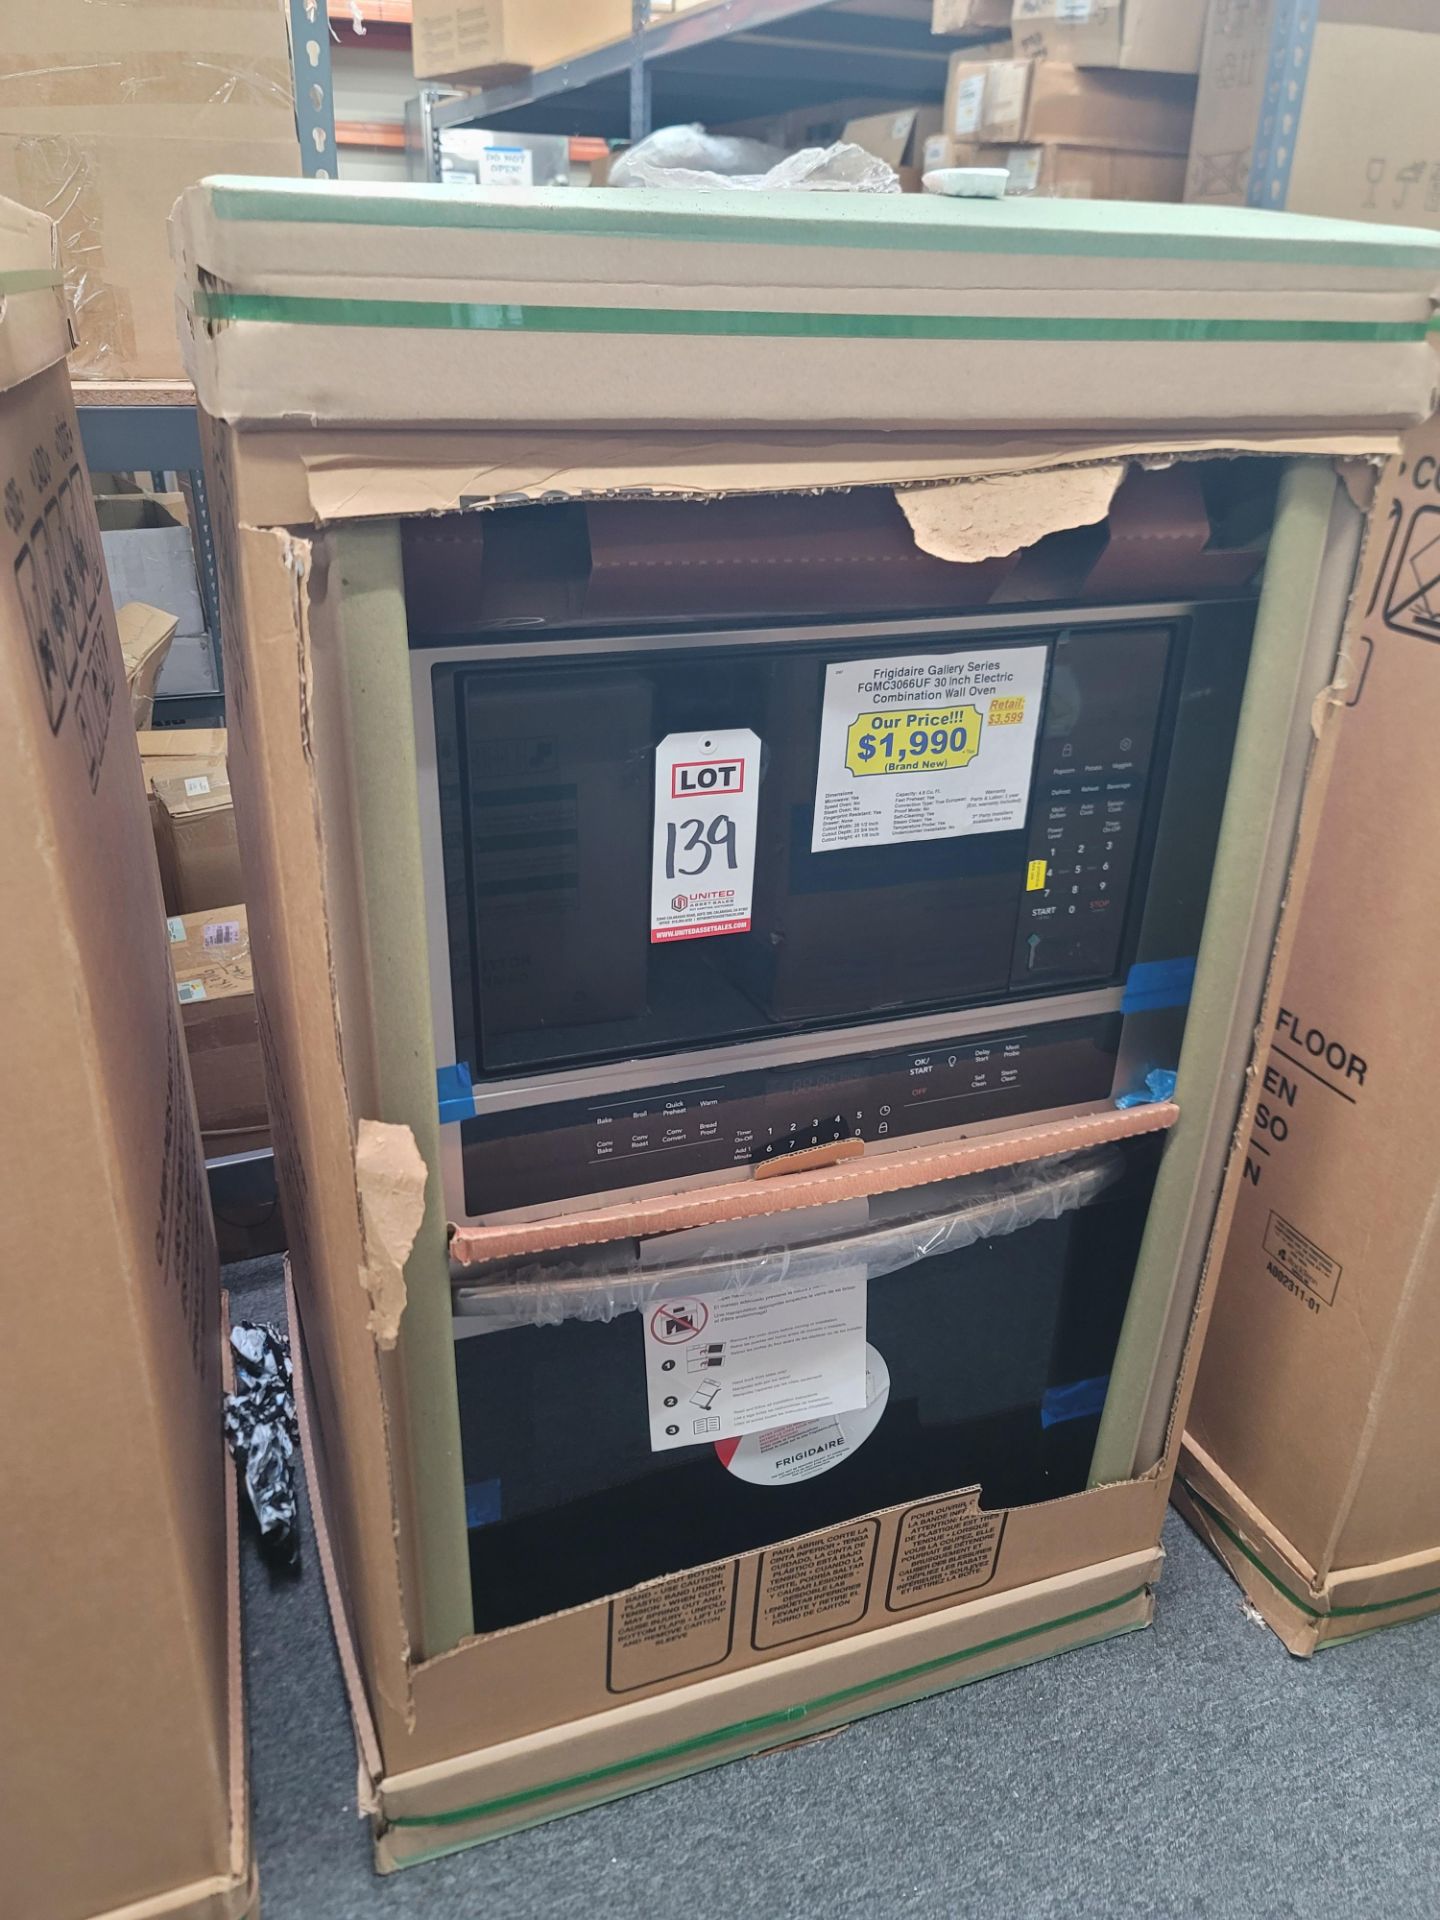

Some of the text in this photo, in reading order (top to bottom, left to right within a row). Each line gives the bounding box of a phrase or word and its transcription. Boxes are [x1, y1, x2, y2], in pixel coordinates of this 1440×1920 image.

[874, 661, 1000, 680] Frigidaire Gallery Series
[858, 678, 931, 692] FGMC3066UF
[935, 678, 946, 687] 30
[974, 672, 1014, 684] Electric
[873, 686, 996, 703] Combination Wall Oven
[989, 697, 1024, 710] Retail:
[871, 711, 963, 729] Our Price!!!
[858, 727, 967, 762] $1,990
[885, 759, 947, 773] (Brand New)
[681, 767, 736, 791] LOT
[666, 815, 738, 879] 139
[1051, 841, 1113, 856] 1 2 3
[1047, 862, 1109, 876] 4 5 6
[690, 889, 735, 900] UNITED
[1044, 882, 1106, 897] 7 8 9
[1032, 907, 1056, 916] START
[1068, 905, 1075, 914] 0
[656, 922, 747, 938] WWW.UNITEDASSETSALES.COM
[1275, 1007, 1368, 1086] FLOOR
[915, 1057, 930, 1066] OK/
[910, 1066, 933, 1076] START
[912, 1088, 928, 1097] OFF
[1262, 1065, 1298, 1107] EN
[666, 1101, 684, 1109] Quick
[633, 1110, 648, 1118] Broil
[663, 1108, 686, 1116] Preheat
[768, 1127, 772, 1135] 1
[857, 1111, 862, 1119] 5
[766, 1145, 773, 1153] 6
[812, 1136, 817, 1144] 8
[855, 1128, 860, 1136] 0
[1267, 1262, 1320, 1314] A002311-01
[776, 1437, 845, 1469] FRIGIDAIRE
[911, 1510, 934, 1521] POUR
[921, 1514, 946, 1525] BANDE
[911, 1517, 958, 1534] ATTENTION:
[918, 1524, 961, 1539] PLASTIQUE
[913, 1522, 989, 1547] TENDUE LORSQUE
[773, 1546, 795, 1557] PARA
[827, 1530, 855, 1542] CORTE
[827, 1545, 852, 1557] CINTA
[770, 1554, 795, 1565] CINTA
[840, 1549, 862, 1561] BAJO
[687, 1565, 726, 1580] BOTTOM
[815, 1559, 851, 1573] CUANDO
[660, 1585, 679, 1594] USE
[692, 1580, 723, 1593] UNDER
[669, 1595, 696, 1607] WHEN
[698, 1589, 716, 1599] CUT
[682, 1602, 701, 1610] OUT
[702, 1594, 722, 1604] AND
